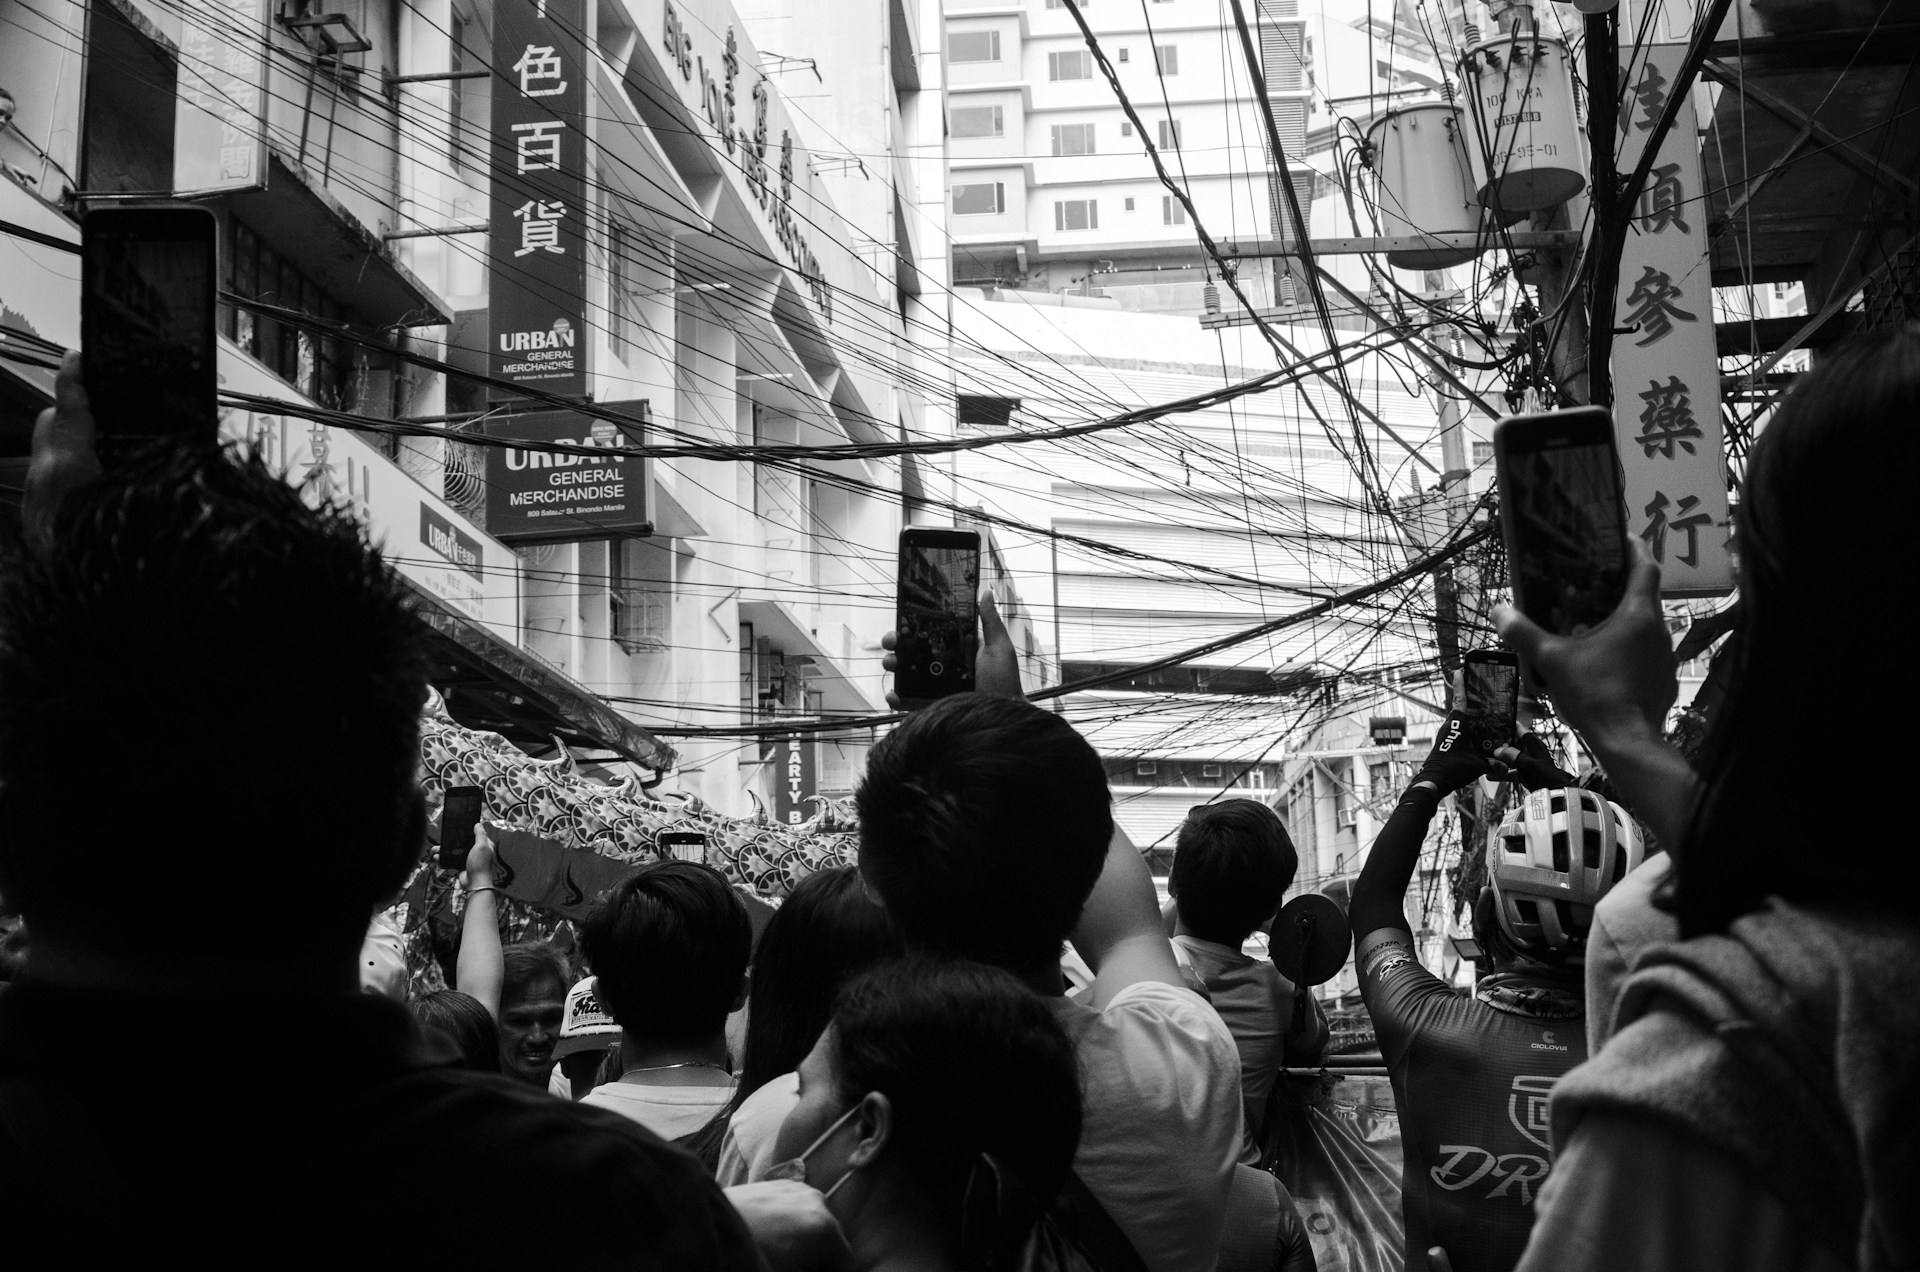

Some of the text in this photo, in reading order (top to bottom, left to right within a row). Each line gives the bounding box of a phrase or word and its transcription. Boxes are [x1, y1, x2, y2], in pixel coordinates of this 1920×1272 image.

[512, 0, 568, 257] 色百貨
[501, 329, 575, 351] URBAN
[527, 350, 574, 362] GENERAL
[502, 361, 574, 374] MERCHANDISE
[506, 434, 624, 471] URBAN
[549, 468, 624, 486] GENERAL
[510, 484, 624, 507] MERCHANDISE
[527, 510, 540, 518] 809
[576, 506, 603, 514] Binondo
[429, 523, 458, 562] URBAN
